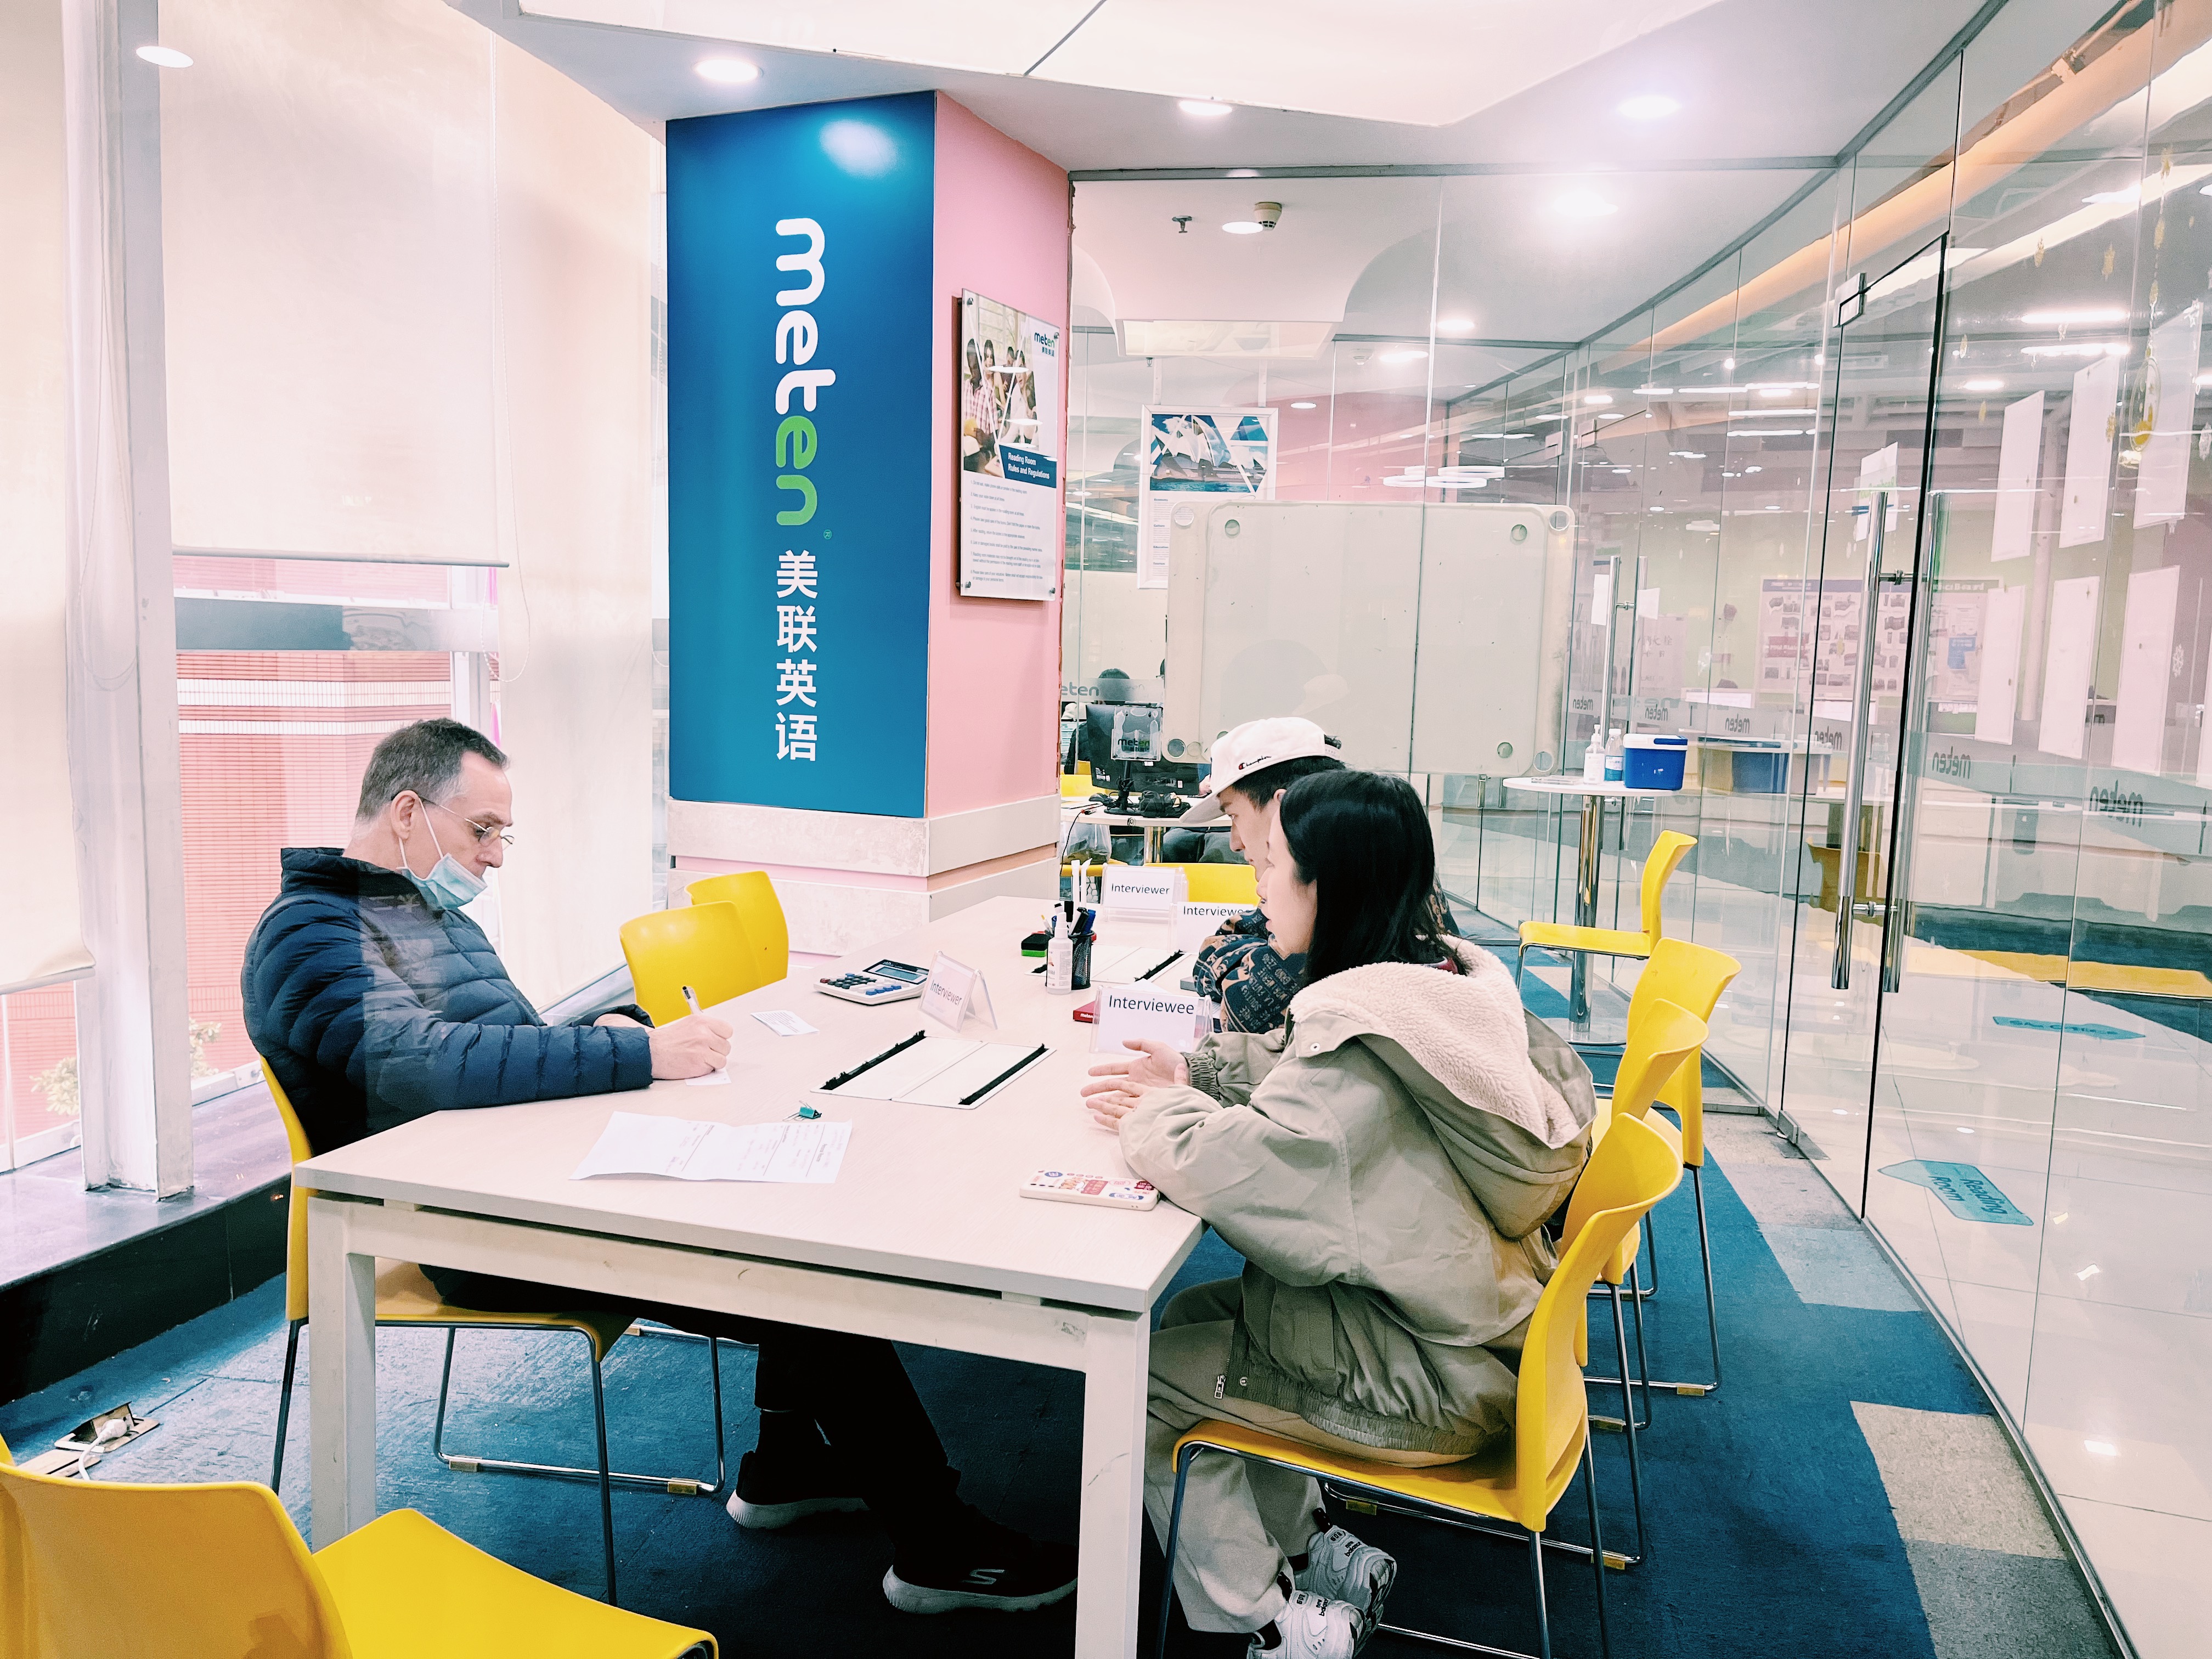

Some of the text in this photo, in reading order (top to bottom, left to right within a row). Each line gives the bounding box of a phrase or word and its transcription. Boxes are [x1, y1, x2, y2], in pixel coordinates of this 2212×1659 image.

[1034, 332, 1055, 348] meten
[775, 217, 836, 526] meten
[1008, 452, 1036, 466] Reading Room
[1008, 463, 1019, 473] Rules
[1028, 467, 1049, 479] Regulations
[775, 549, 819, 761] 美联英语
[1061, 681, 1099, 697] eten
[1111, 883, 1170, 895] Interviewer
[1183, 905, 1248, 917] Interviewe
[929, 979, 962, 1006] Interviewer
[1109, 994, 1195, 1015] Interviewee
[1928, 1176, 2008, 1215] Reading Room
